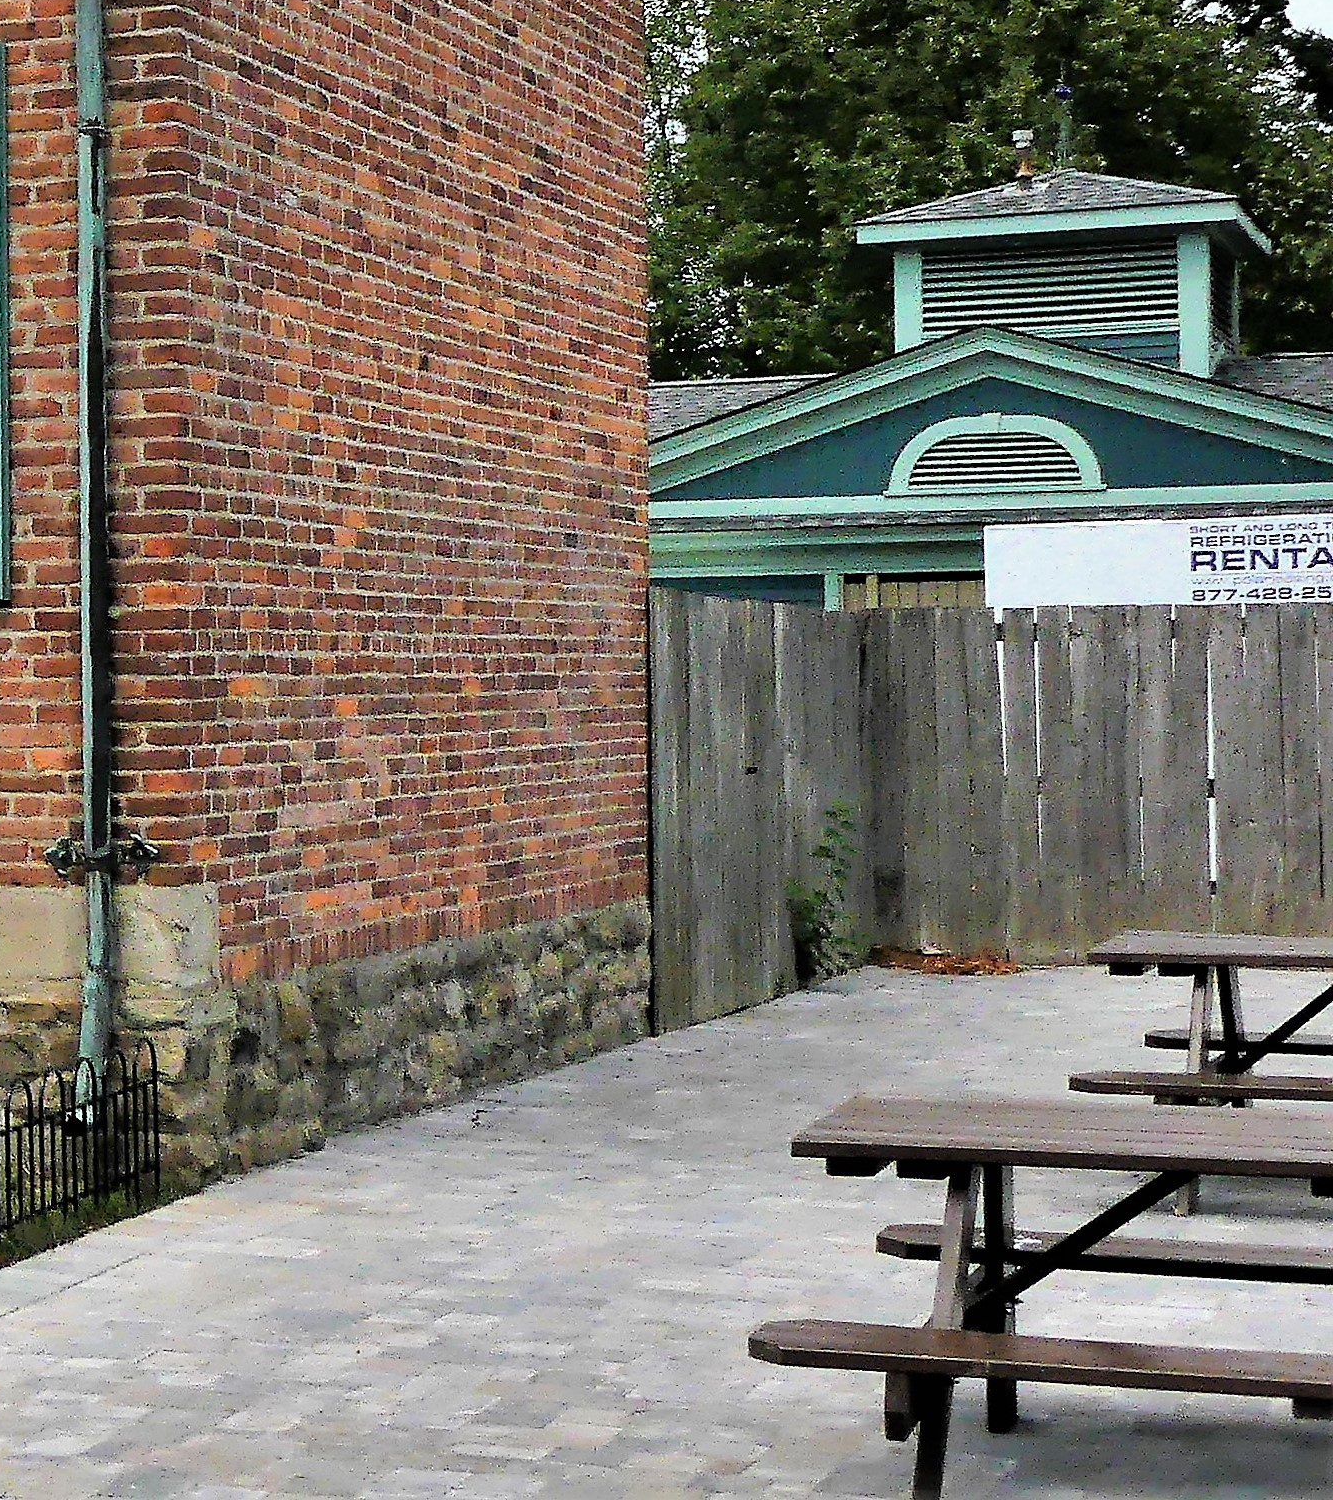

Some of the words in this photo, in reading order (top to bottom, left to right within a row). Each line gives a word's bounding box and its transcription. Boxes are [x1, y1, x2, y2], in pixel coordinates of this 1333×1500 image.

[1189, 524, 1238, 534] SHORT
[1243, 523, 1275, 532] AND
[1279, 521, 1319, 531] LONG
[1190, 532, 1333, 548] REFRIGERATI
[1190, 547, 1333, 572] RENTA
[1192, 585, 1333, 602] 877-428-25
